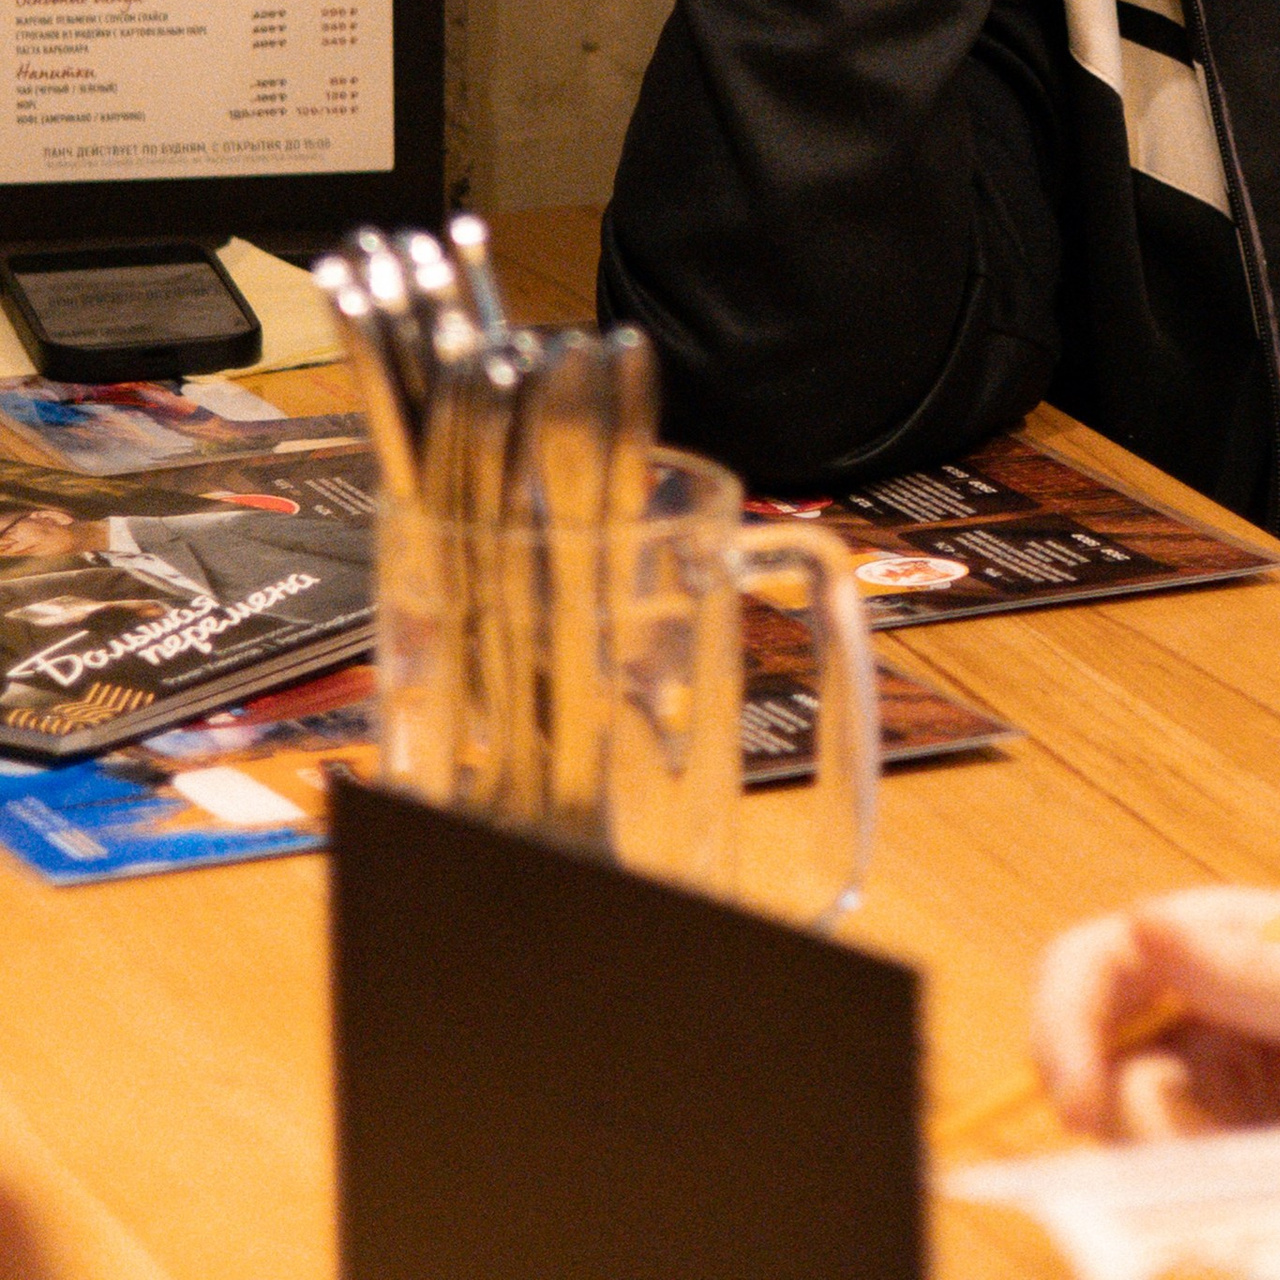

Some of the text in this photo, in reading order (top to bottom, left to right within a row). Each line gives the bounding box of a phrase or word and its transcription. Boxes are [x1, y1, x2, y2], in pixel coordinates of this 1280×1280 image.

[16, 61, 96, 81] Напитки
[6, 594, 220, 687] Большая
[139, 573, 321, 666] перемена
